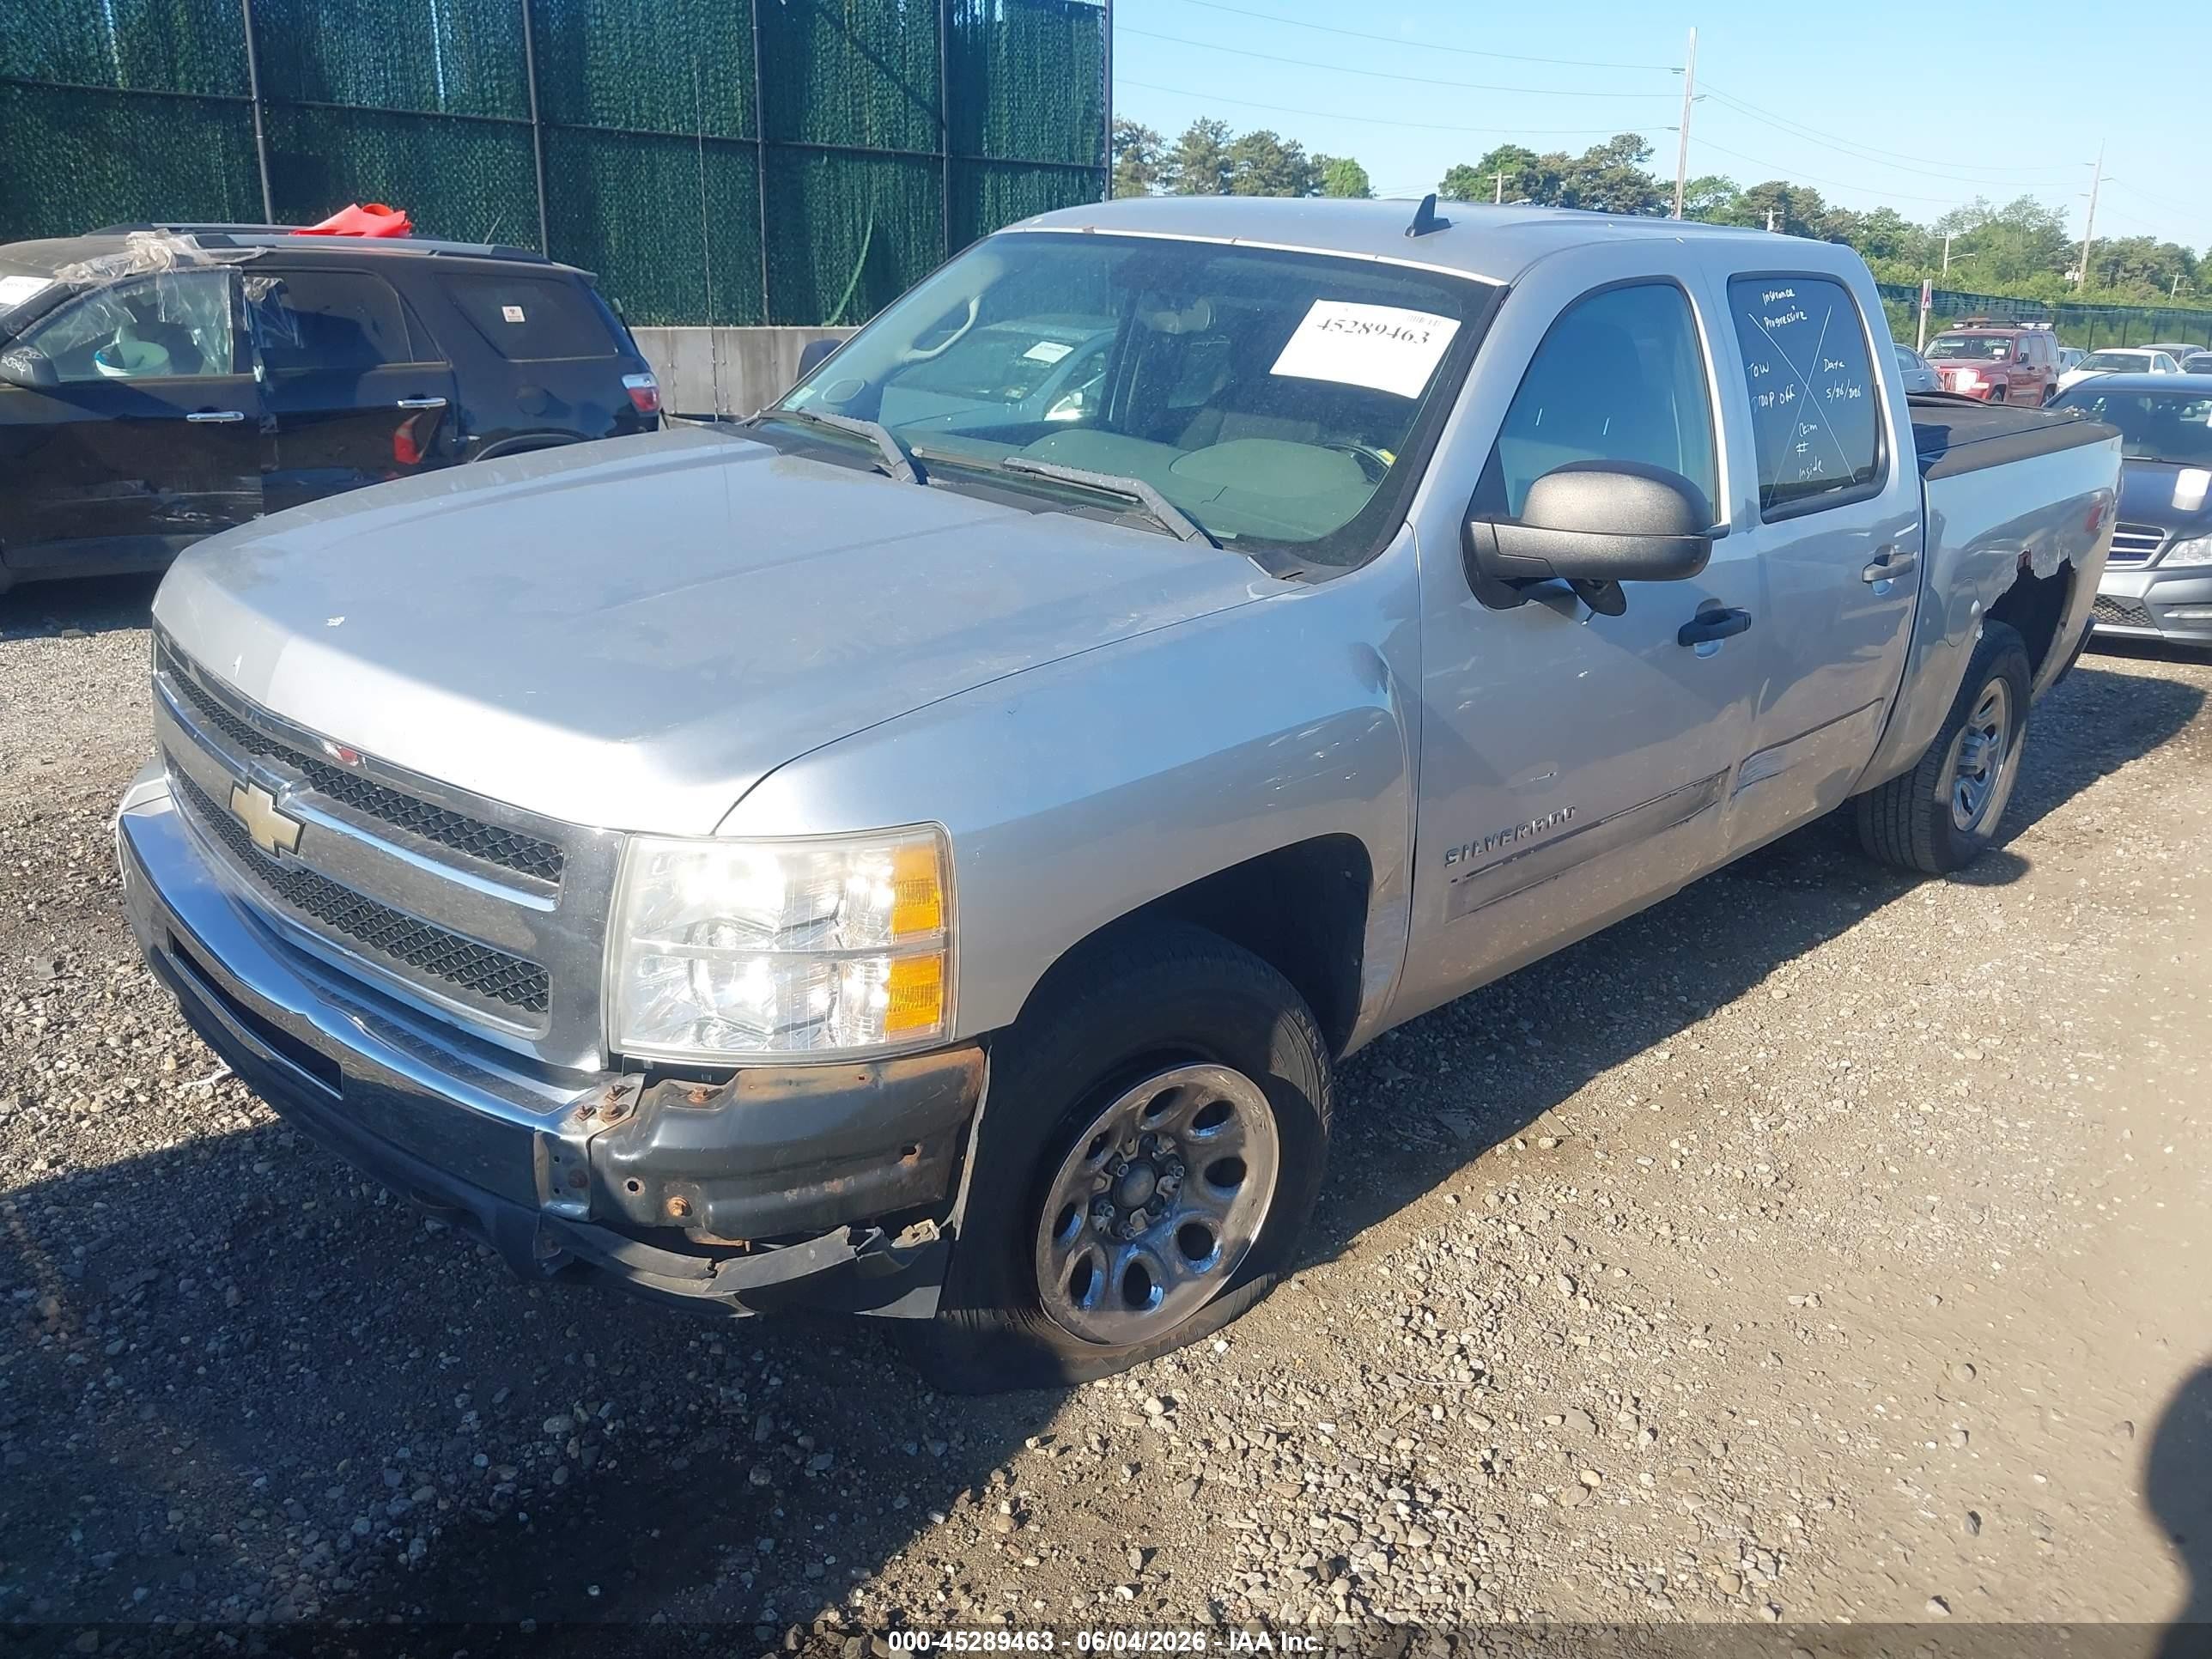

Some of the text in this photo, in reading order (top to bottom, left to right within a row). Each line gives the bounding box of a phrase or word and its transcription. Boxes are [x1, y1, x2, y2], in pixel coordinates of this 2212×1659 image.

[1316, 317, 1431, 344] 45289463
[1764, 305, 1808, 331] Progressive
[1824, 358, 1845, 373] Date
[1796, 441, 1809, 459] #
[1444, 804, 1576, 868] SILVERADO
